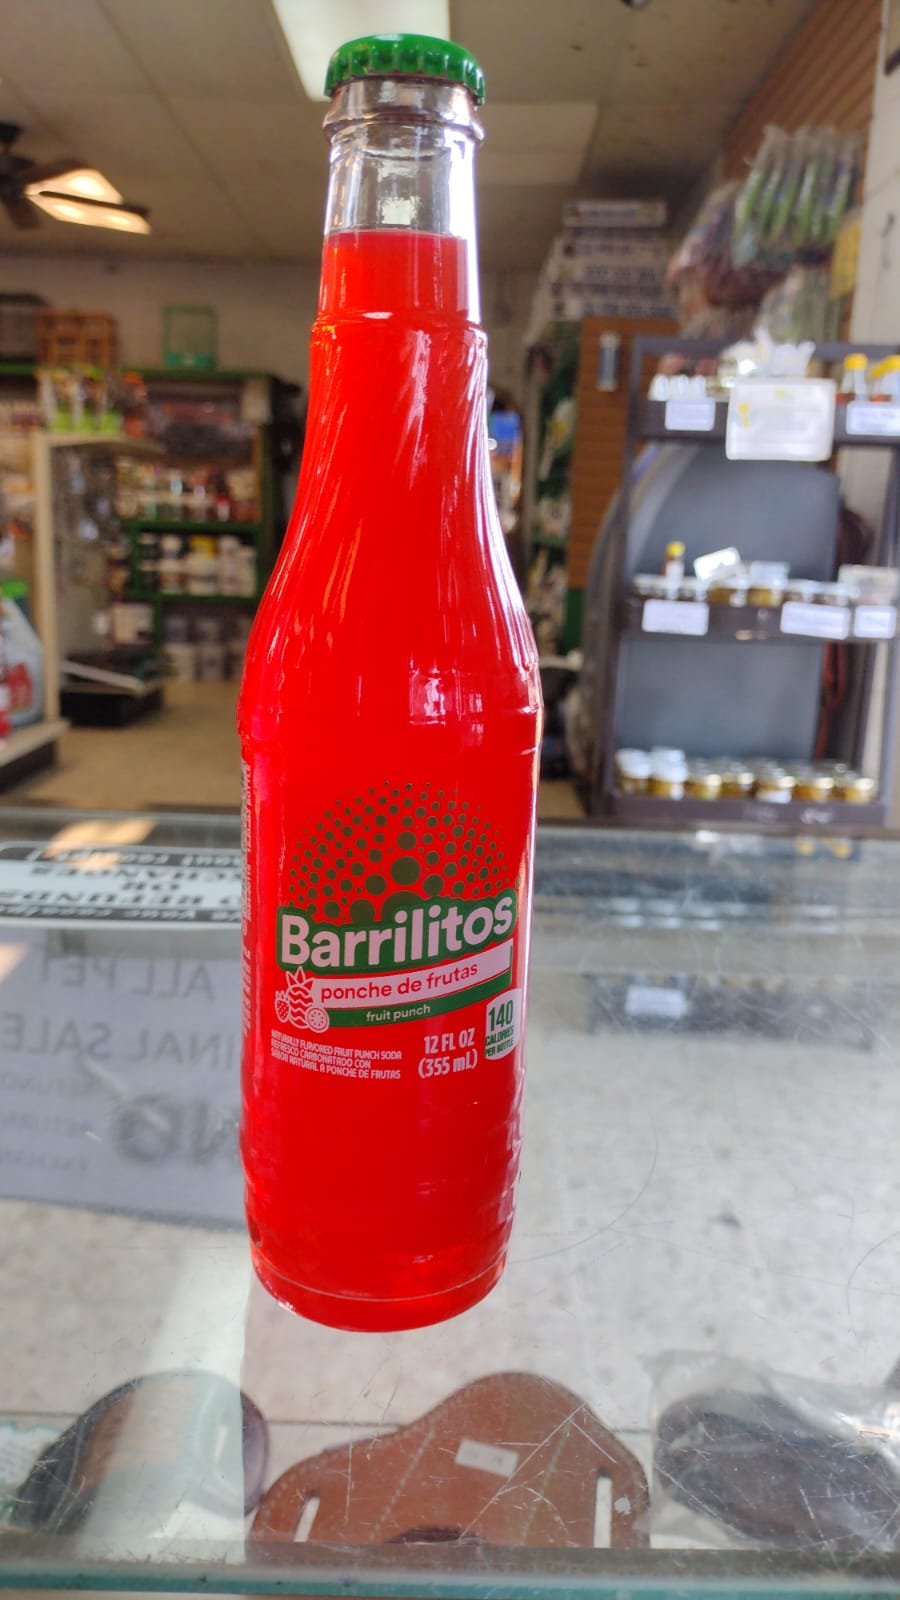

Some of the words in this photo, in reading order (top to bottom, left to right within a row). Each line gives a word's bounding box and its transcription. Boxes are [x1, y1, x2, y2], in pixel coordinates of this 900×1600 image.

[281, 896, 513, 967] Barrilitos
[321, 982, 392, 1003] ponche
[397, 977, 422, 994] de
[426, 963, 478, 989] frutas
[366, 1011, 391, 1022] fruit
[393, 1004, 431, 1021] punch
[488, 999, 513, 1032] 140
[271, 1029, 300, 1047] NATURALLY
[300, 1039, 333, 1055] FLAVORED
[333, 1046, 354, 1058] FRUIT
[354, 1050, 380, 1060] PUNCH
[381, 1050, 402, 1060] SODA
[424, 1035, 439, 1054] 12
[441, 1032, 456, 1052] FL
[458, 1027, 475, 1048] OZ
[486, 1025, 514, 1046] CALORIES
[271, 1038, 299, 1057] REFRESCO
[300, 1049, 353, 1067] CARBONATADO
[354, 1059, 371, 1069] CON
[271, 1047, 288, 1063] SABOR
[289, 1055, 318, 1072] NATURAL
[319, 1064, 326, 1073] A
[326, 1065, 357, 1078] PONCHE
[359, 1069, 370, 1079] DE
[371, 1069, 401, 1079] FRUTAS
[418, 1056, 451, 1079] (355
[452, 1048, 479, 1073] mL)
